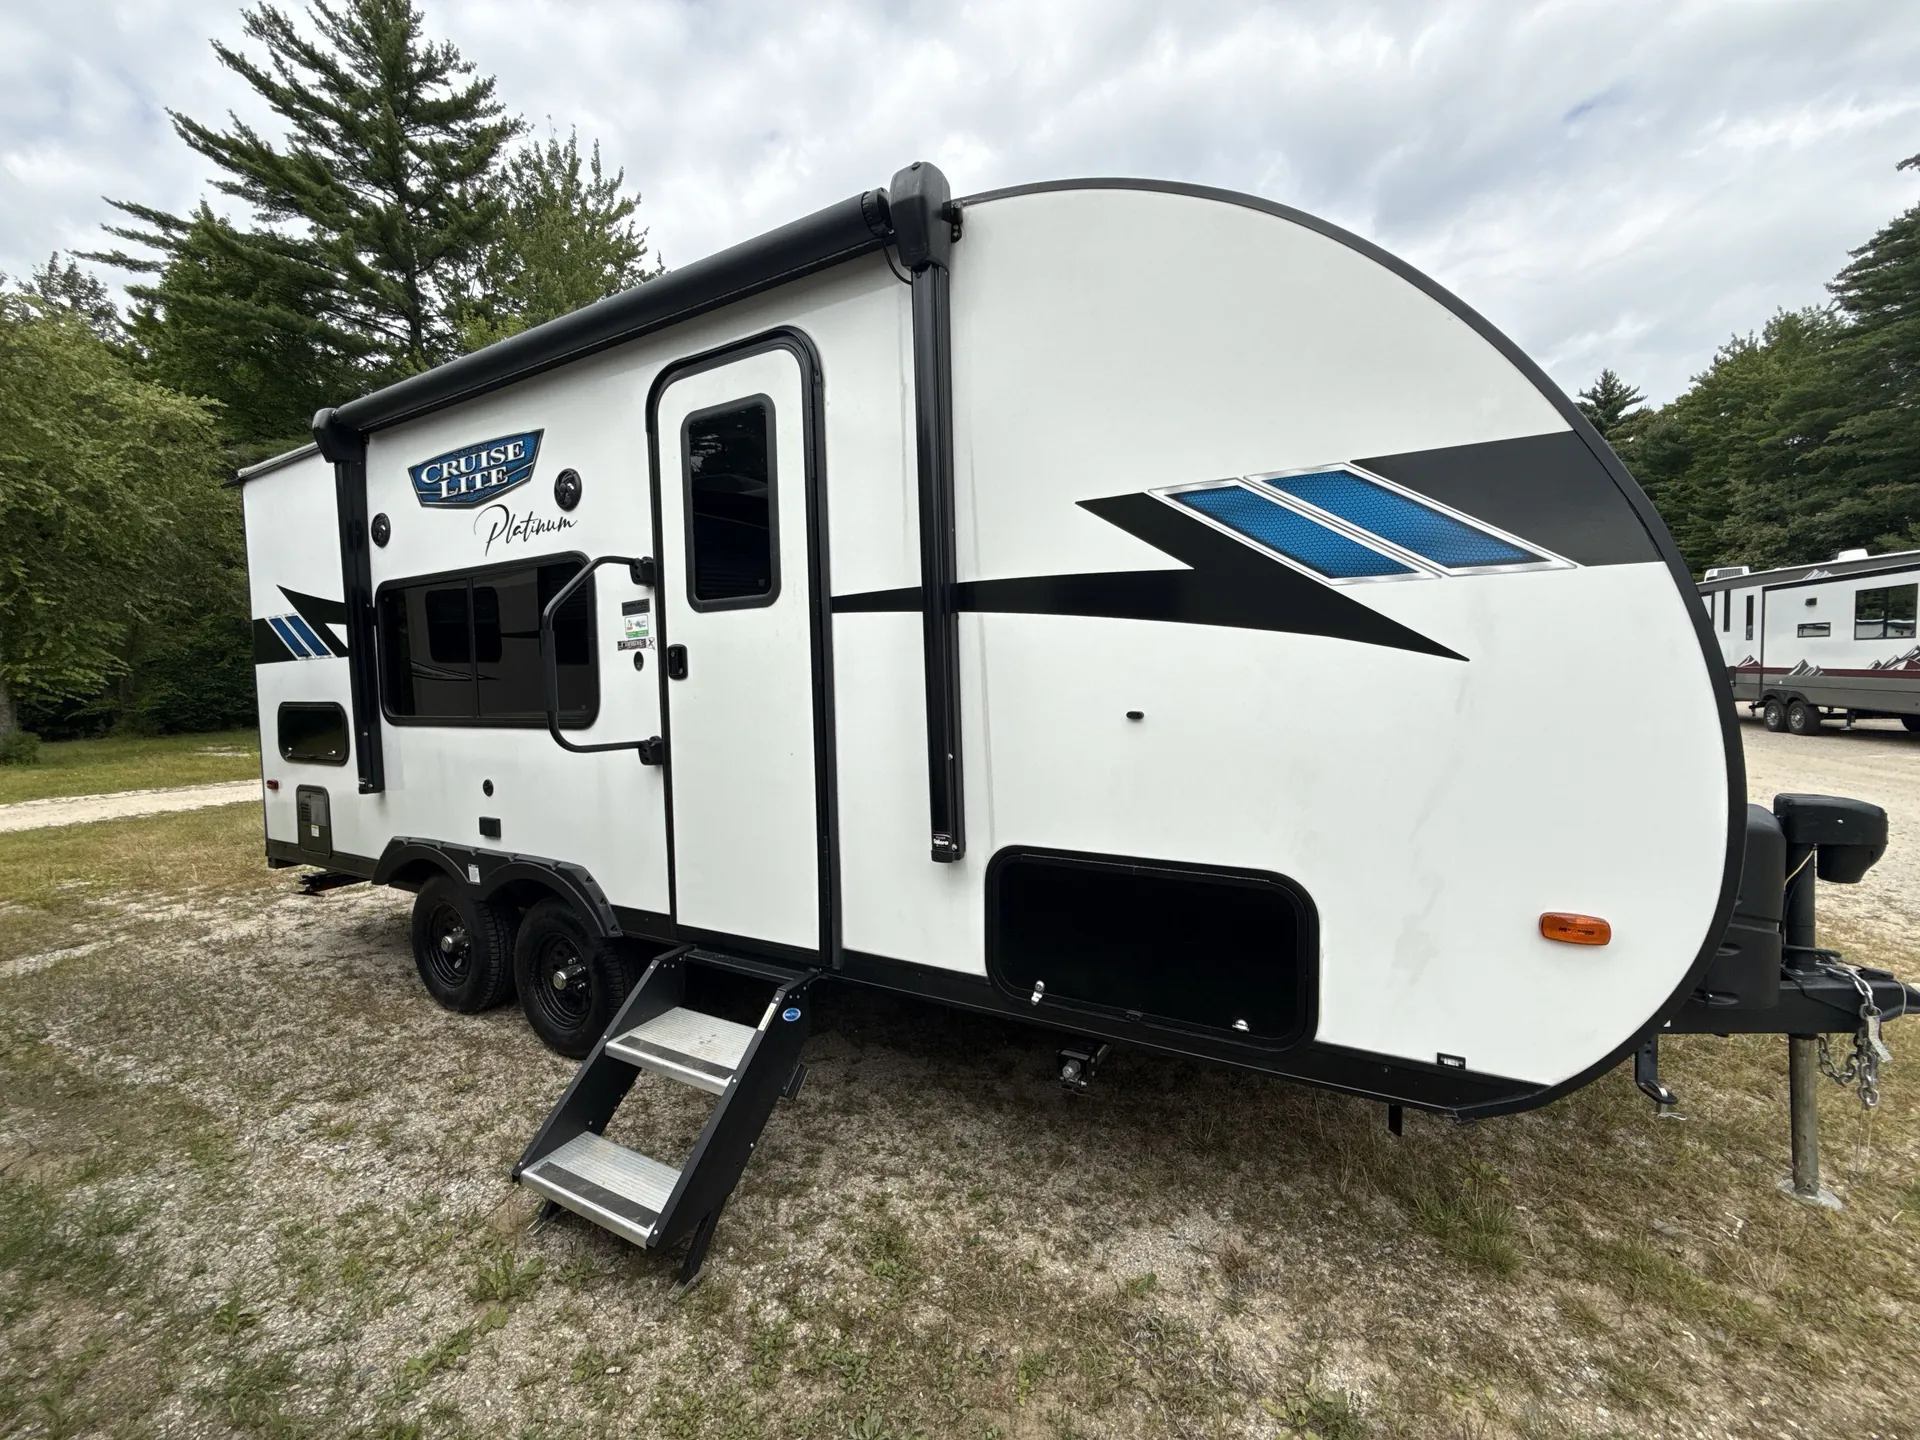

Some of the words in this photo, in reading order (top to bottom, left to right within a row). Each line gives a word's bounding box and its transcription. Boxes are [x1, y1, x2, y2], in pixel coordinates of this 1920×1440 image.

[421, 440, 525, 484] CRUISE
[439, 466, 509, 499] LITE
[473, 503, 578, 557] Platinum
